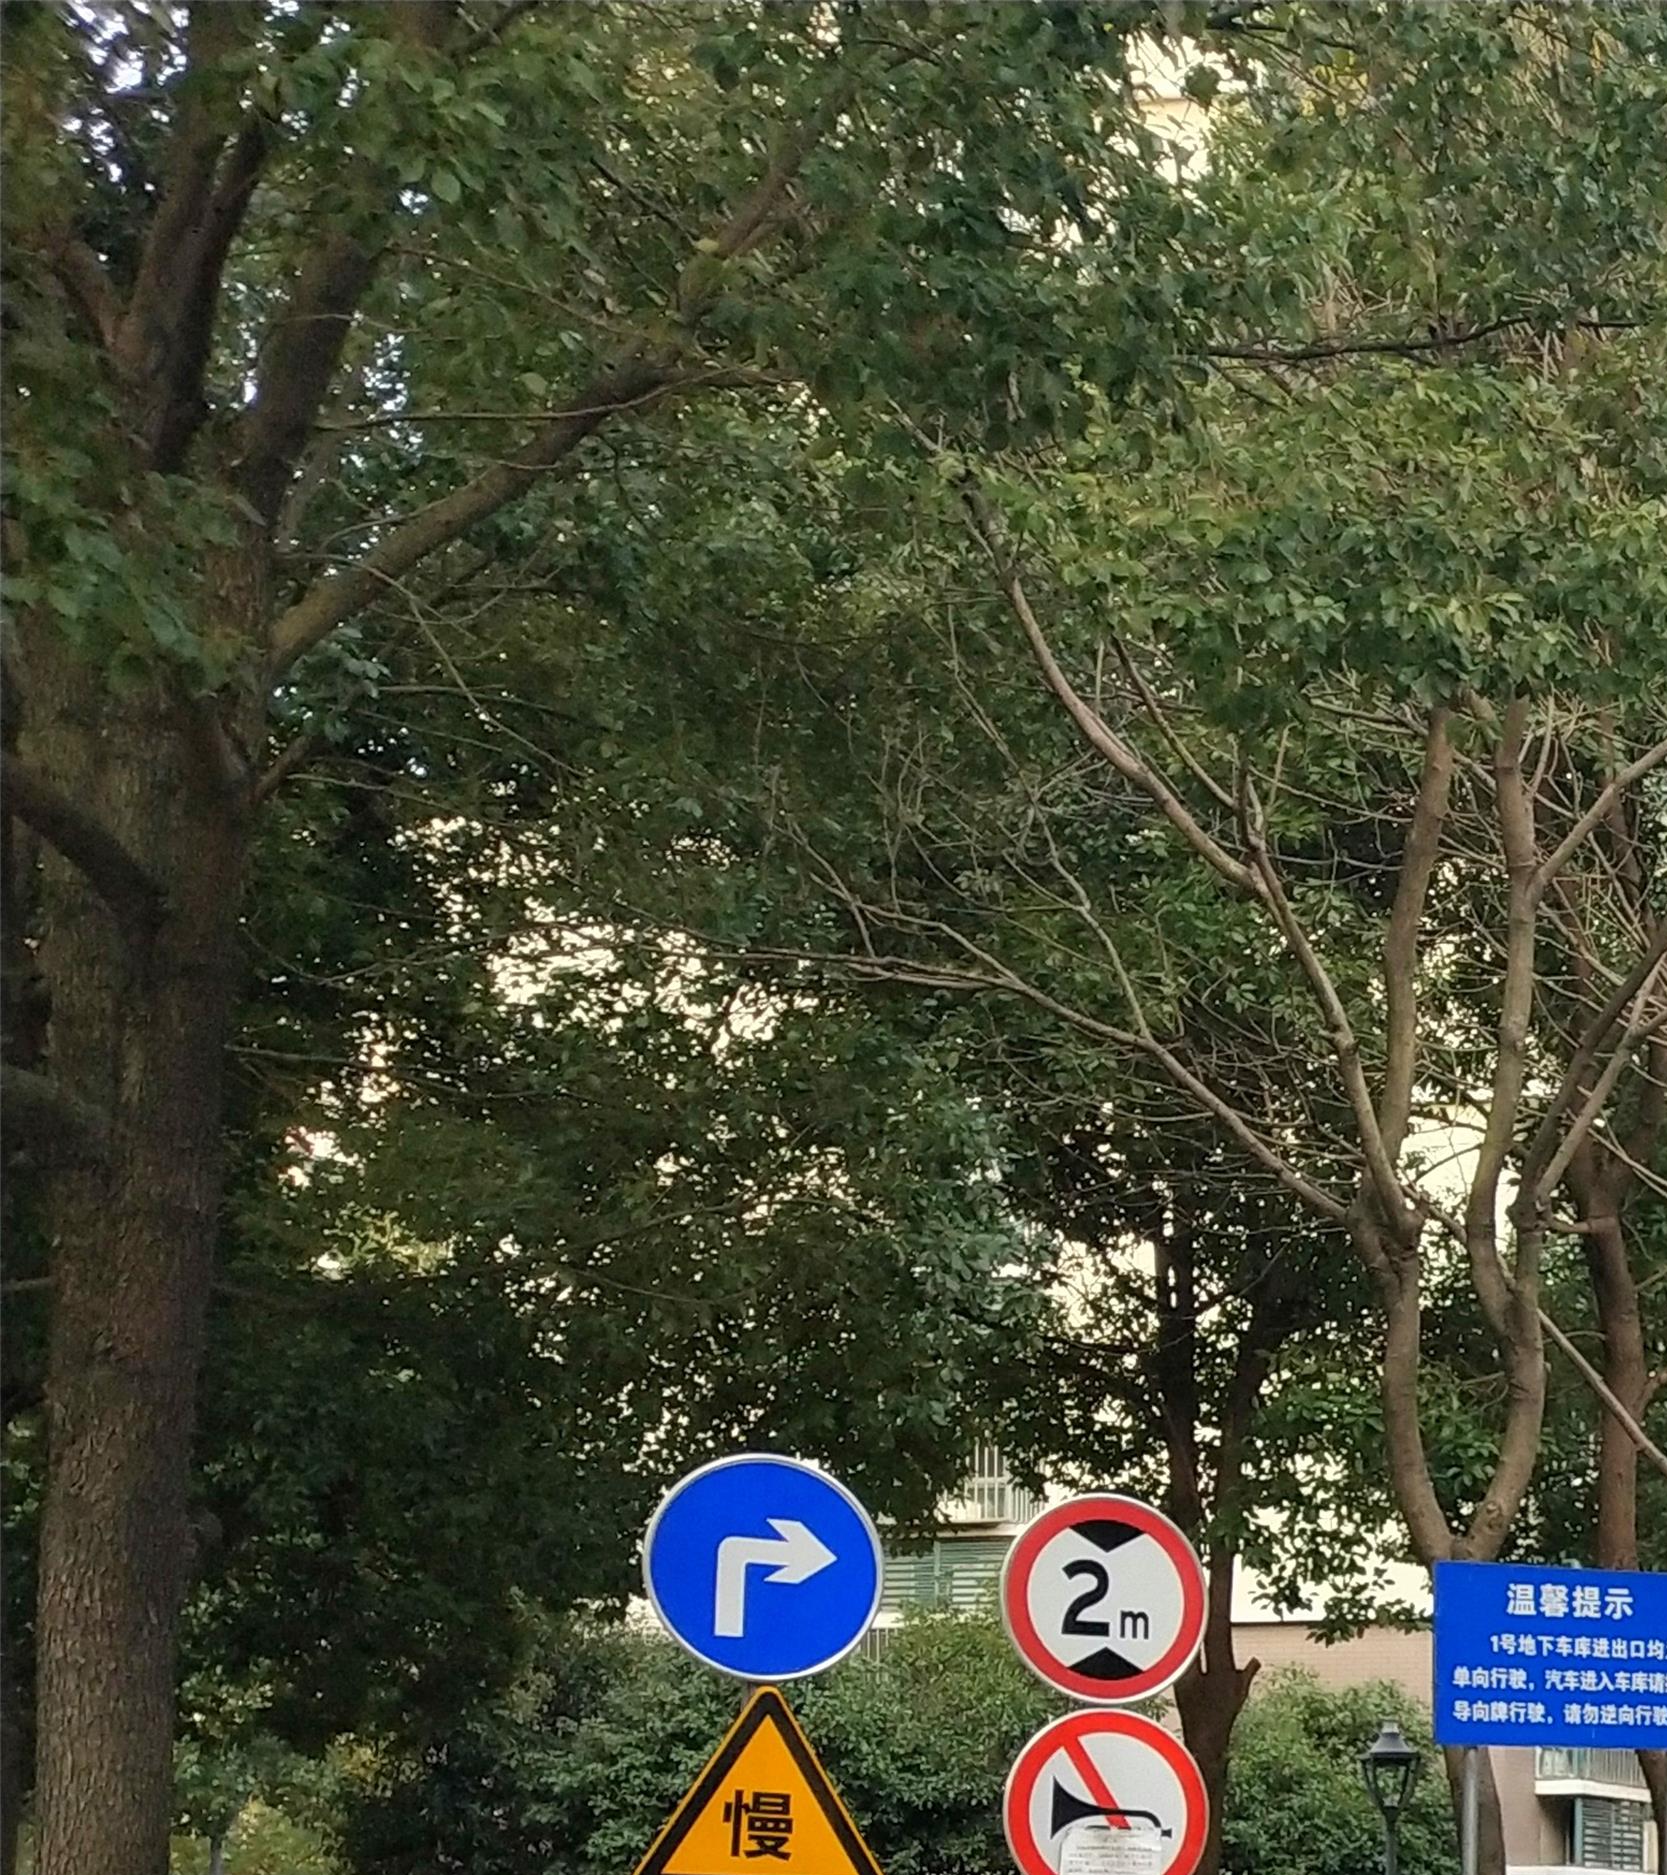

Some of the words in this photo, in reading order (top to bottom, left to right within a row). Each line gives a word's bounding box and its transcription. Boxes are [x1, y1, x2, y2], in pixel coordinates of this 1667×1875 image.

[1506, 1583, 1634, 1619] 温馨提示
[722, 1788, 793, 1861] 慢
